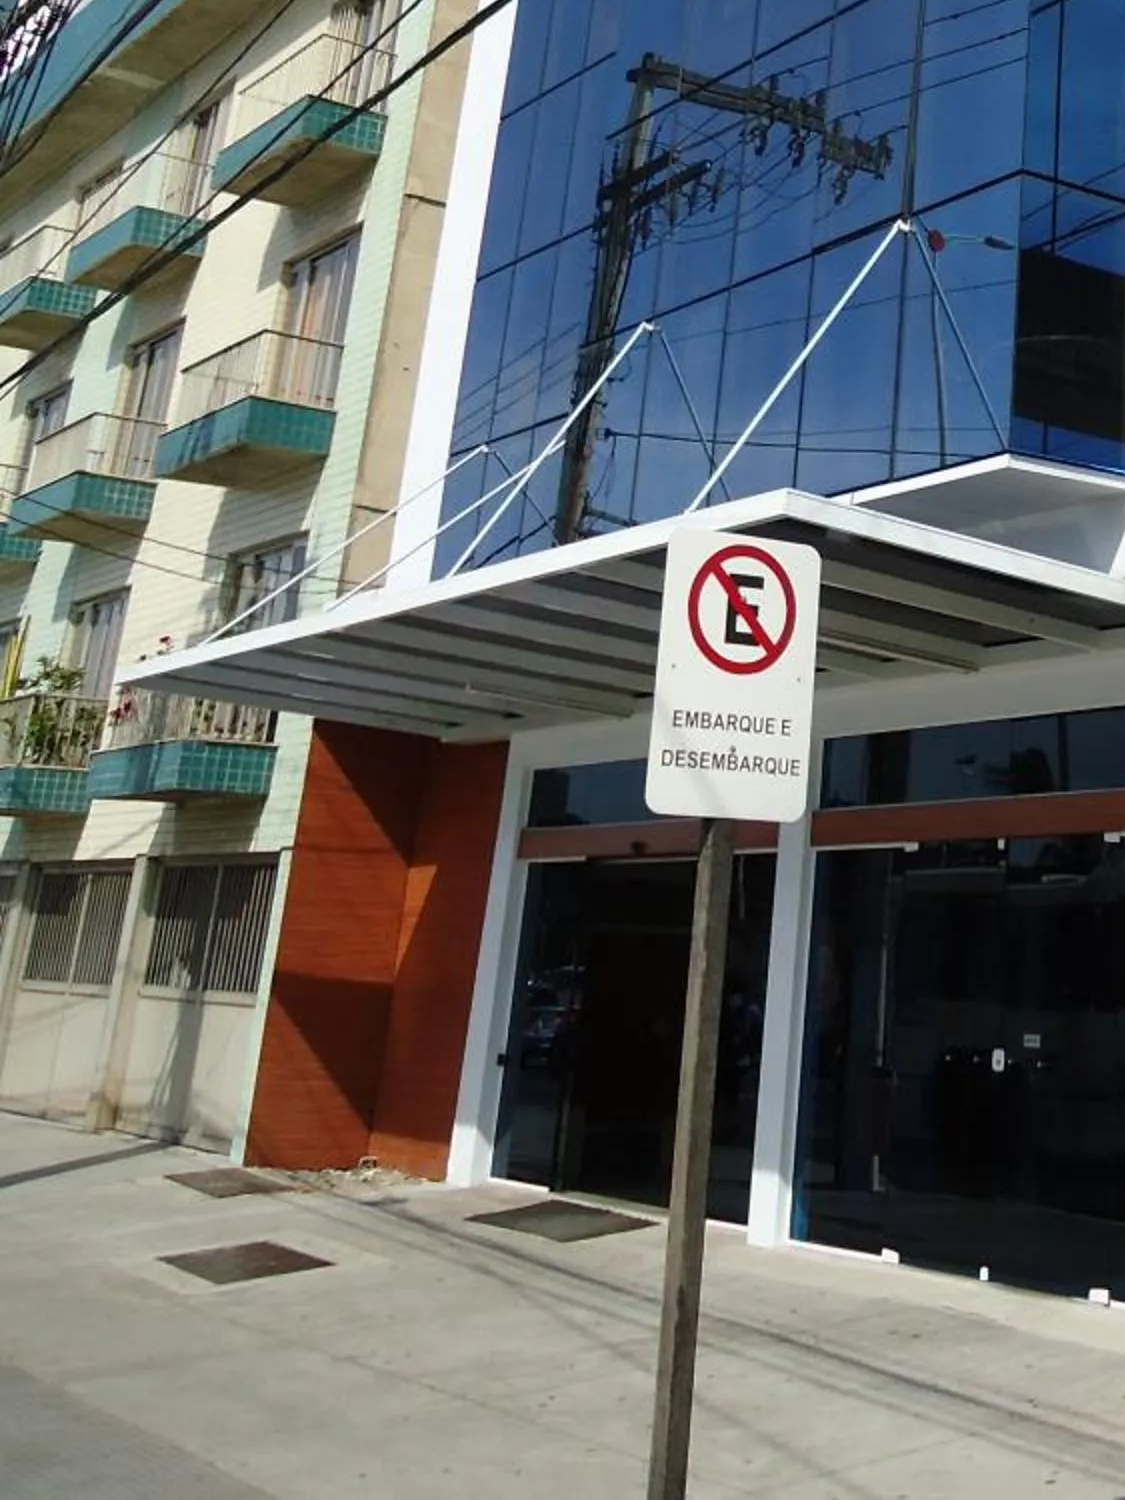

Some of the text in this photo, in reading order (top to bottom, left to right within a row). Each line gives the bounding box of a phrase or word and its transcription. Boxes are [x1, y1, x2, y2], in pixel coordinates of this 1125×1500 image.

[724, 572, 765, 647] E
[672, 709, 791, 736] EMBARQUE E
[661, 749, 801, 776] DESEMBARQUE
